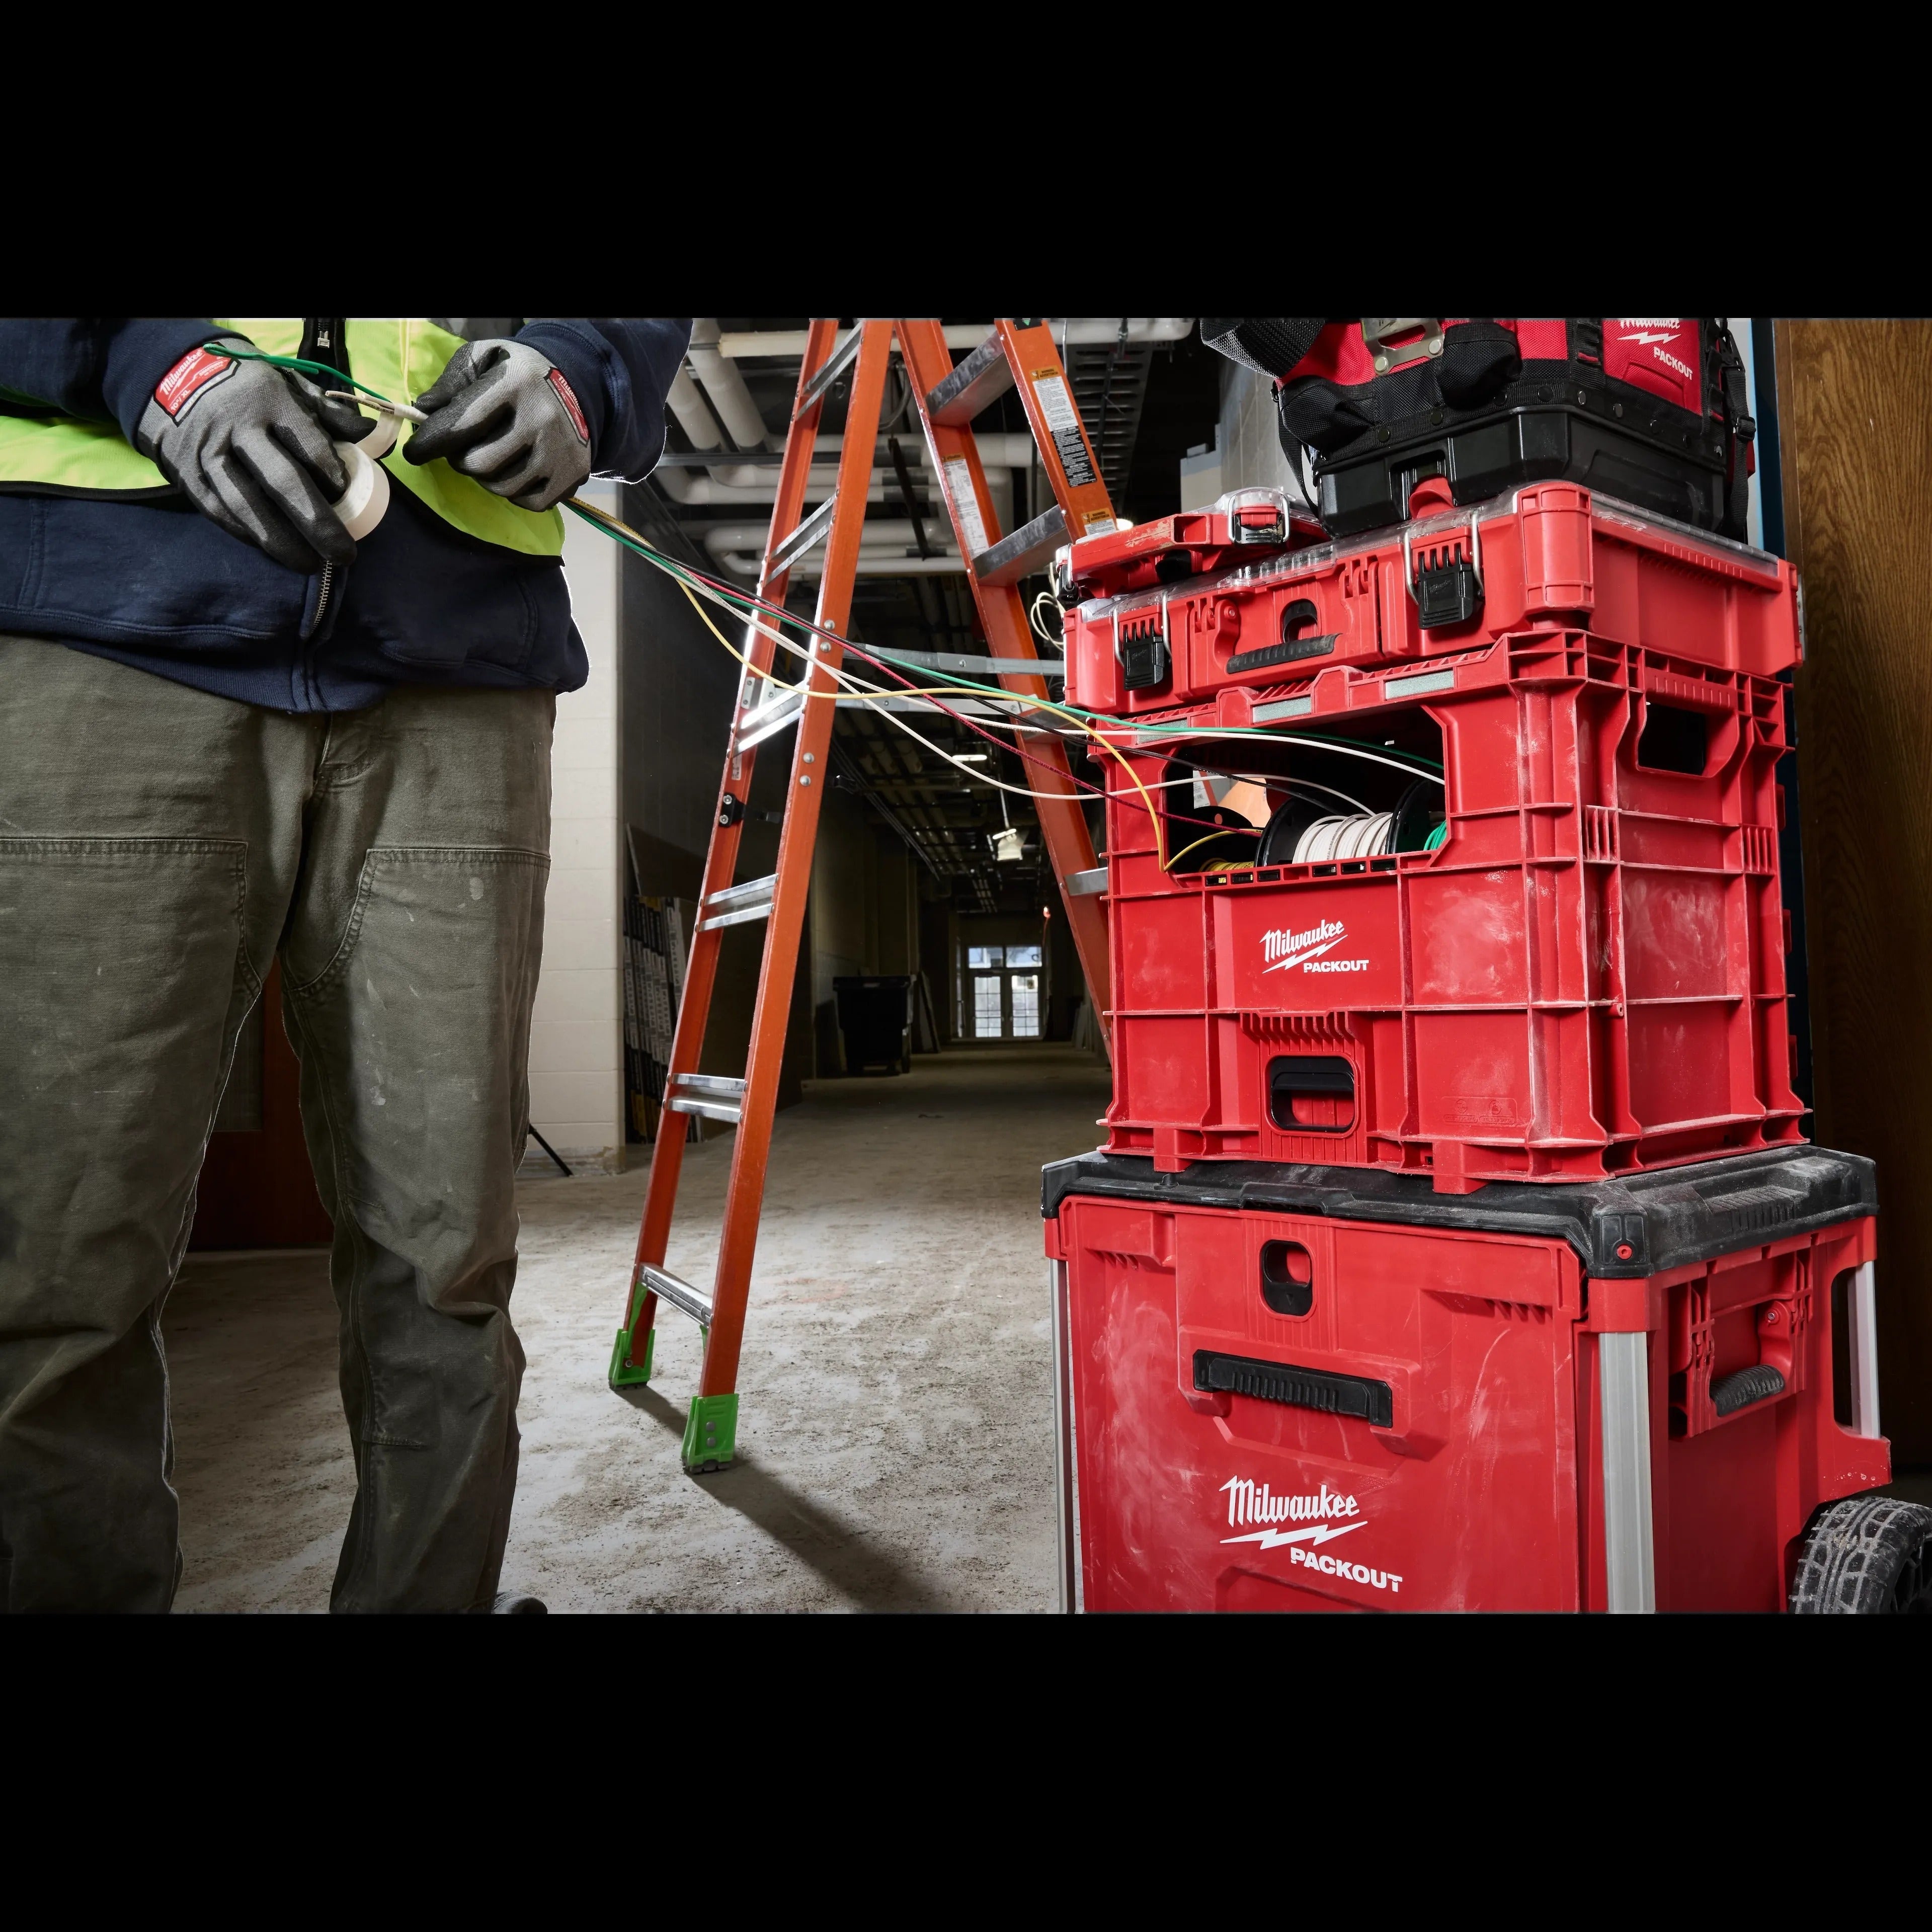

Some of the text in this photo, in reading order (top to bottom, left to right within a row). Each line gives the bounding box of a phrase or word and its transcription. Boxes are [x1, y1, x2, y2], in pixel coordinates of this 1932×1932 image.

[159, 349, 202, 395] Milwaukee
[1654, 346, 1693, 380] PACKOUT
[1259, 919, 1345, 963] Milwaukee
[1304, 959, 1369, 973] PACKOUT
[1219, 1475, 1359, 1527] Milwaukee
[1290, 1547, 1403, 1592] PACKOUT
